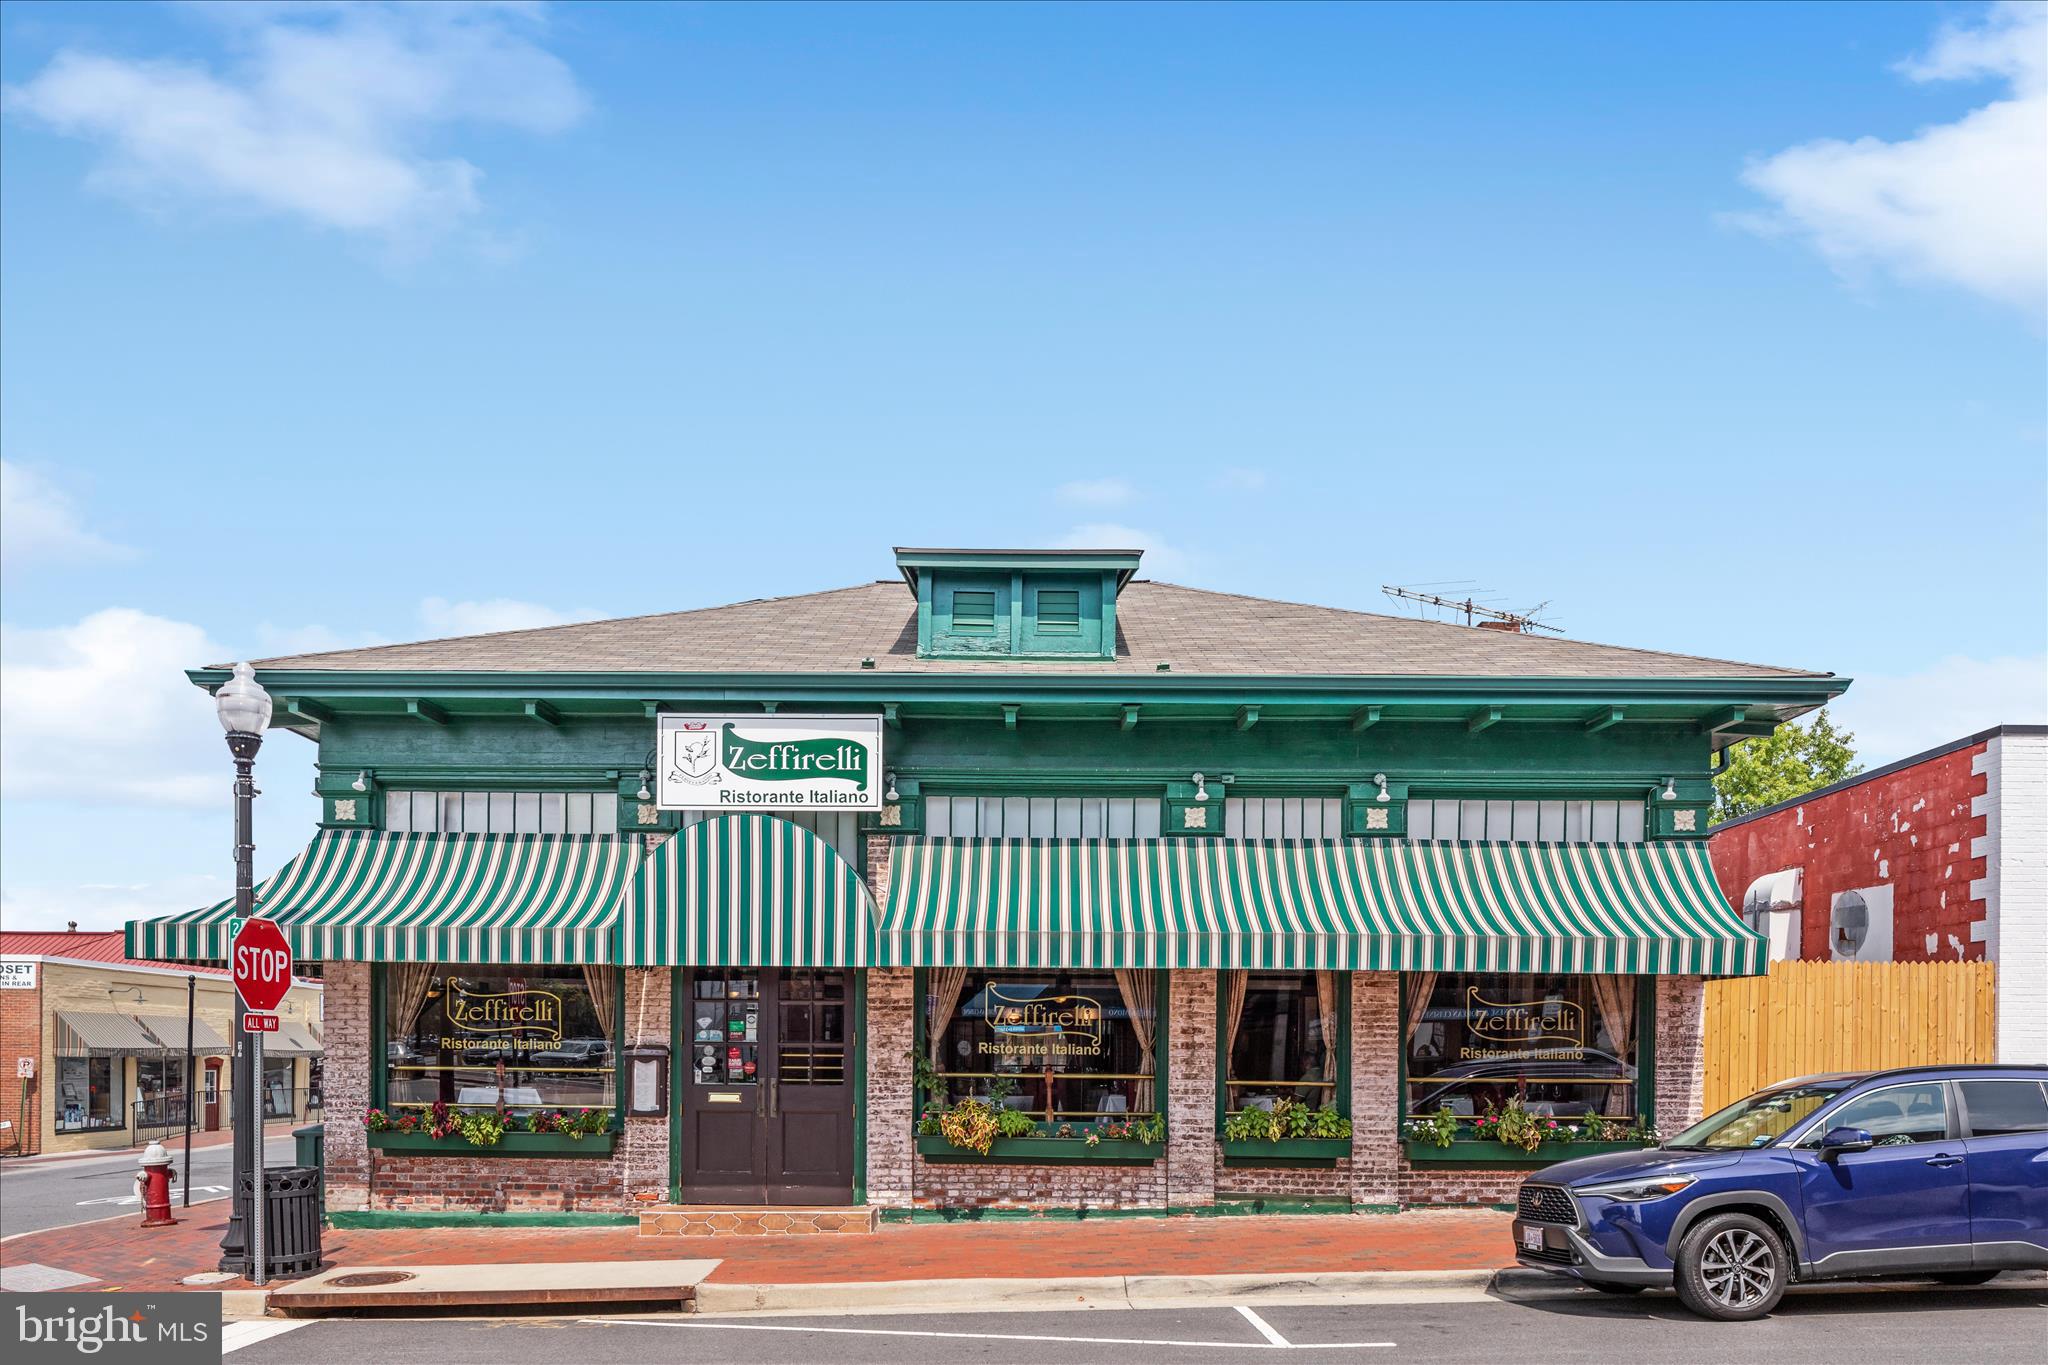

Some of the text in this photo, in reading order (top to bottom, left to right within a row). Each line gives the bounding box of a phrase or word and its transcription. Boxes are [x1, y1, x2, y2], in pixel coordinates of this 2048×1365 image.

[729, 744, 862, 771] Zeffirelli
[720, 789, 869, 804] Ristorante Italiano
[236, 945, 288, 983] STOP
[454, 999, 552, 1022] Zeffirelli
[993, 1003, 1093, 1027] Zeffirelli
[1475, 1008, 1576, 1031] Zeffirelli
[247, 1017, 277, 1029] ALL WAY
[441, 1037, 562, 1050] Ristorante Italiano
[978, 1041, 1101, 1056] Ristorante Italiano
[1460, 1047, 1584, 1061] Ristorante Italiano
